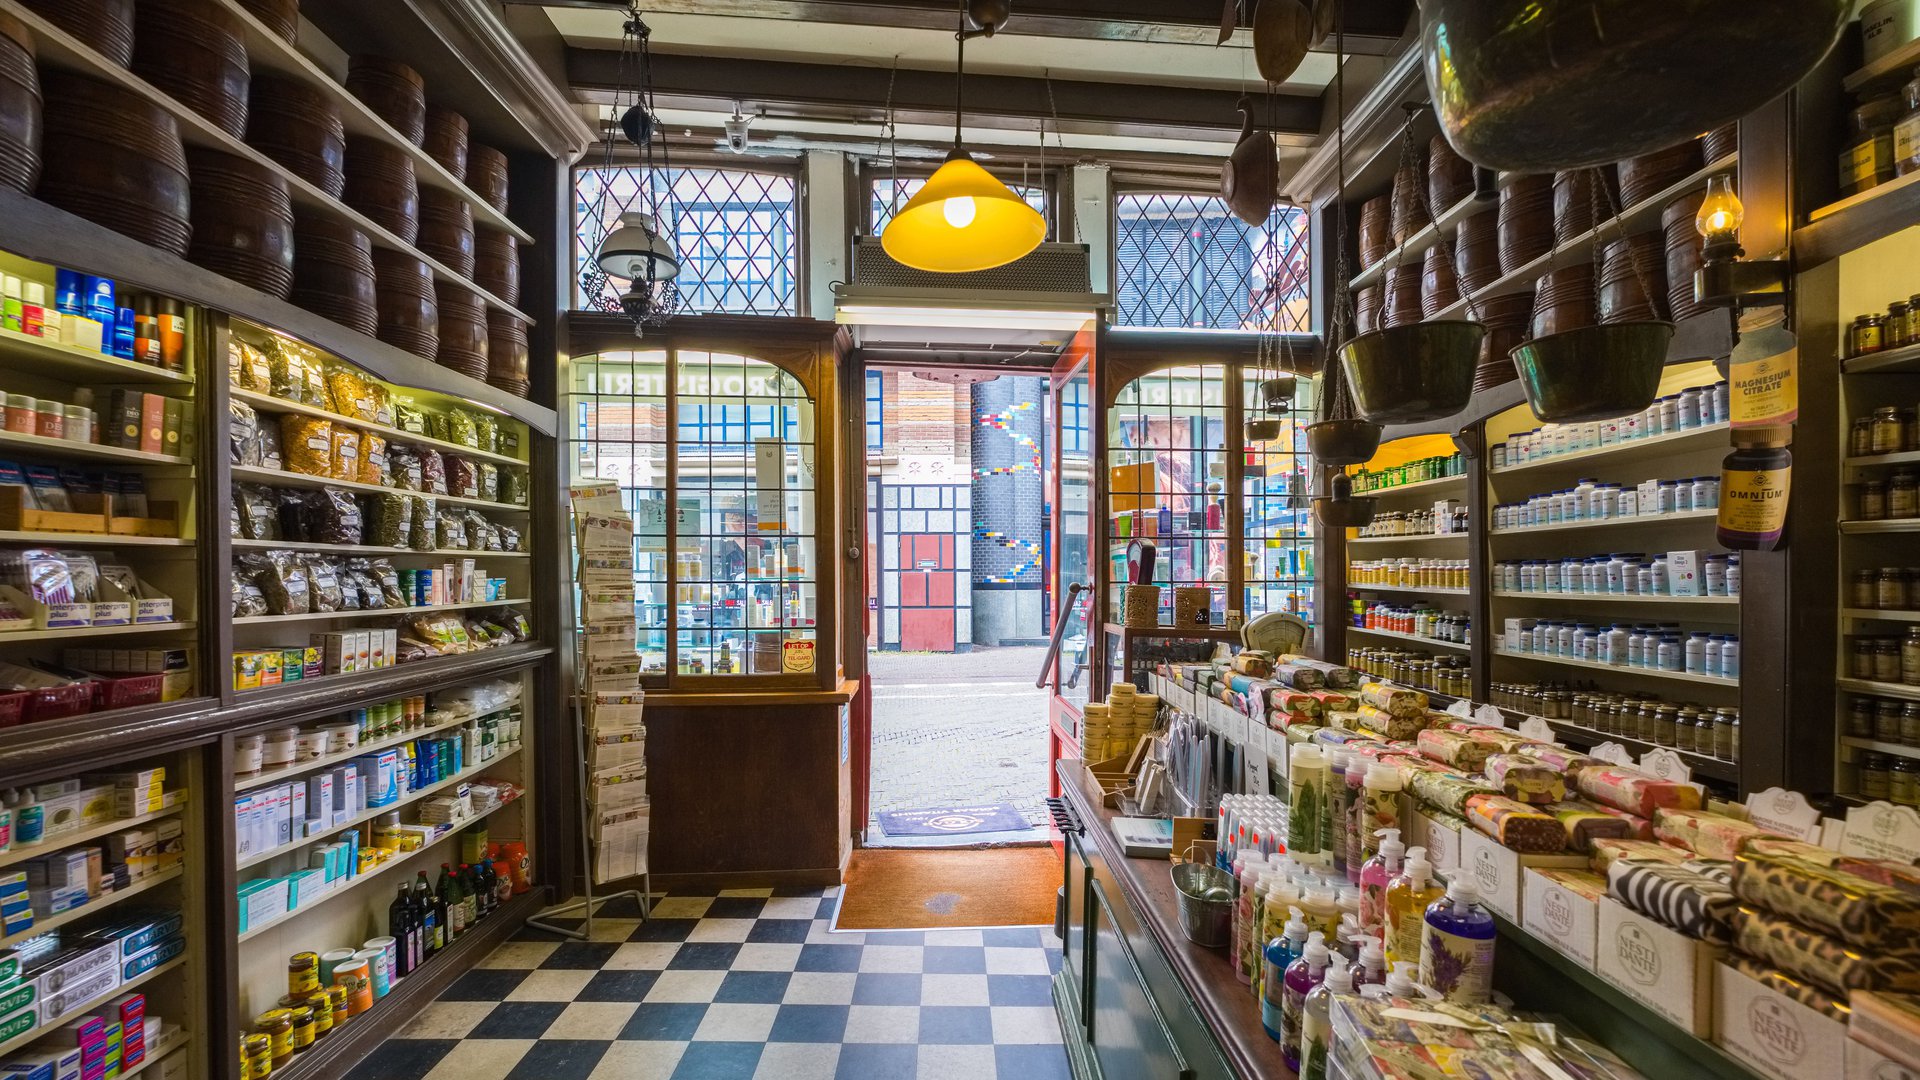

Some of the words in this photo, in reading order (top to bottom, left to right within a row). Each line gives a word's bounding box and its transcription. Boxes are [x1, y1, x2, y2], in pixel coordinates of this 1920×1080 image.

[1734, 368, 1791, 389] MAGNESIUM
[1743, 381, 1782, 396] CITRATE
[1729, 489, 1783, 502] OMNIUM
[50, 610, 68, 618] plus
[95, 609, 111, 617] plus
[138, 607, 154, 615] plus
[1475, 857, 1497, 877] NESTI
[1475, 866, 1498, 887] DANTE
[1544, 898, 1570, 919] NESTI
[1544, 906, 1571, 929] DANTE
[1620, 935, 1656, 964] NESTI
[65, 951, 113, 979] MARVIS
[1619, 946, 1657, 976] DANTE
[65, 974, 113, 1004] MARVIS
[1754, 1008, 1800, 1042] NESTI
[1753, 1020, 1801, 1056] DANTE
